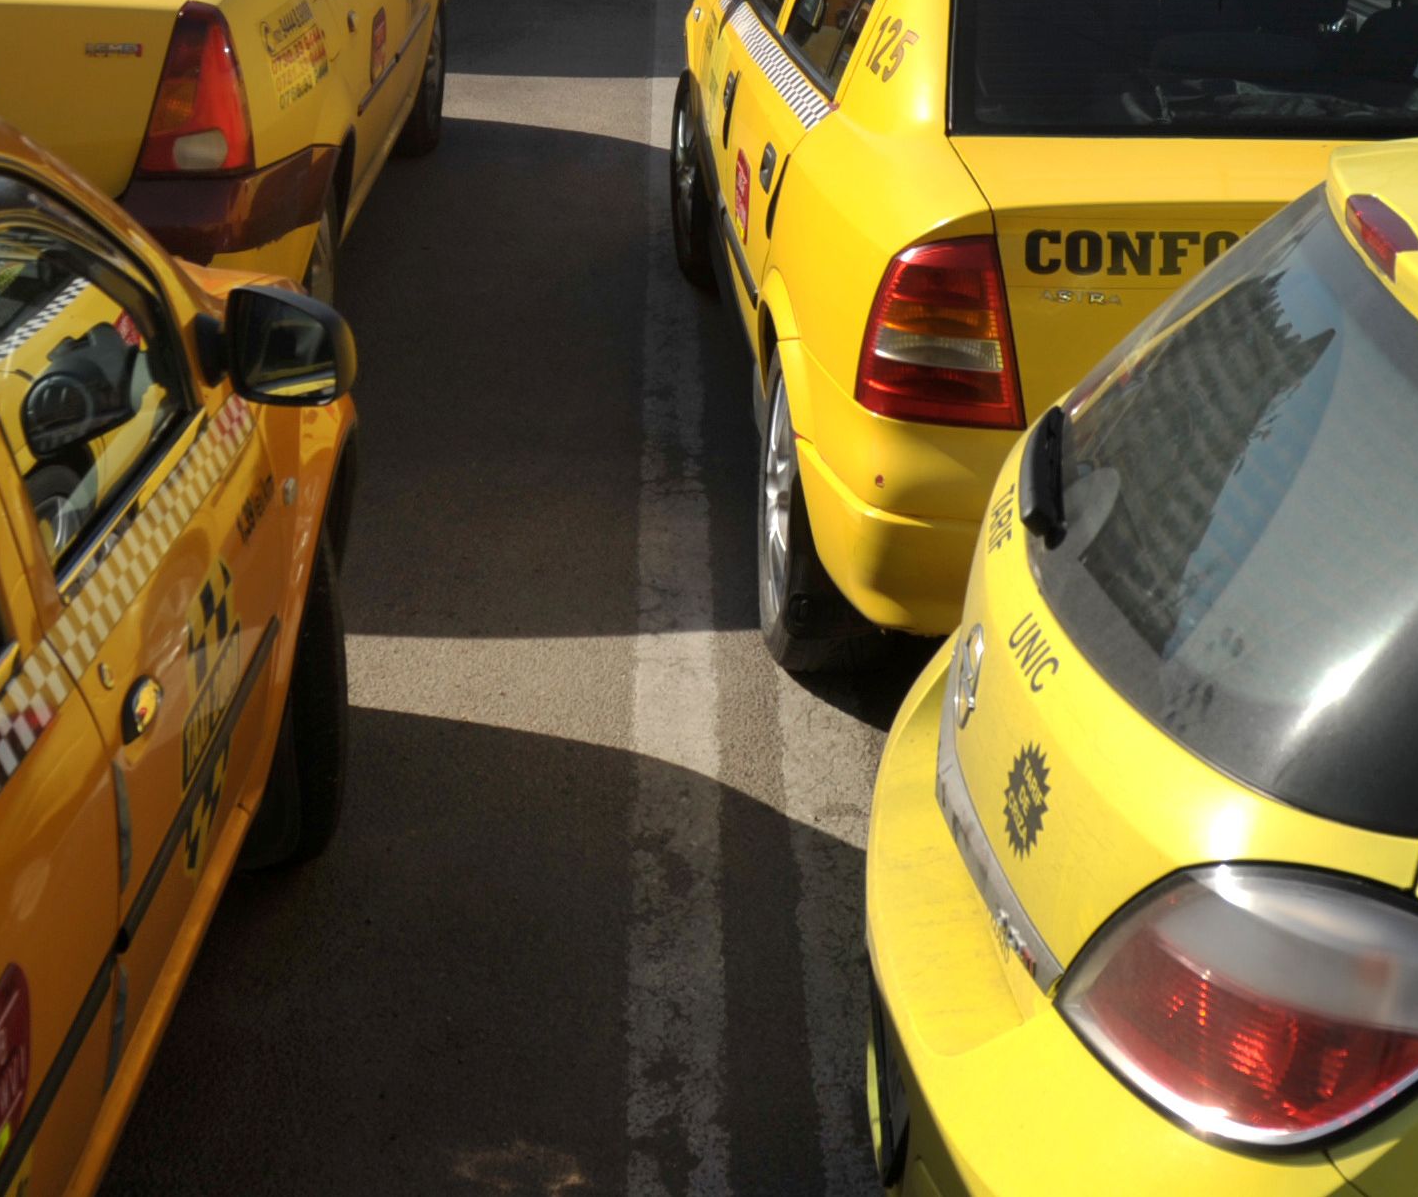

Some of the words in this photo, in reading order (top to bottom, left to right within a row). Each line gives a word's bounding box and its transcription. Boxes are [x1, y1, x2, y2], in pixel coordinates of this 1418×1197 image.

[865, 15, 920, 83] 125
[1024, 228, 1251, 276] CONFO
[988, 481, 1016, 555] TARIF
[1008, 611, 1060, 694] UNIC
